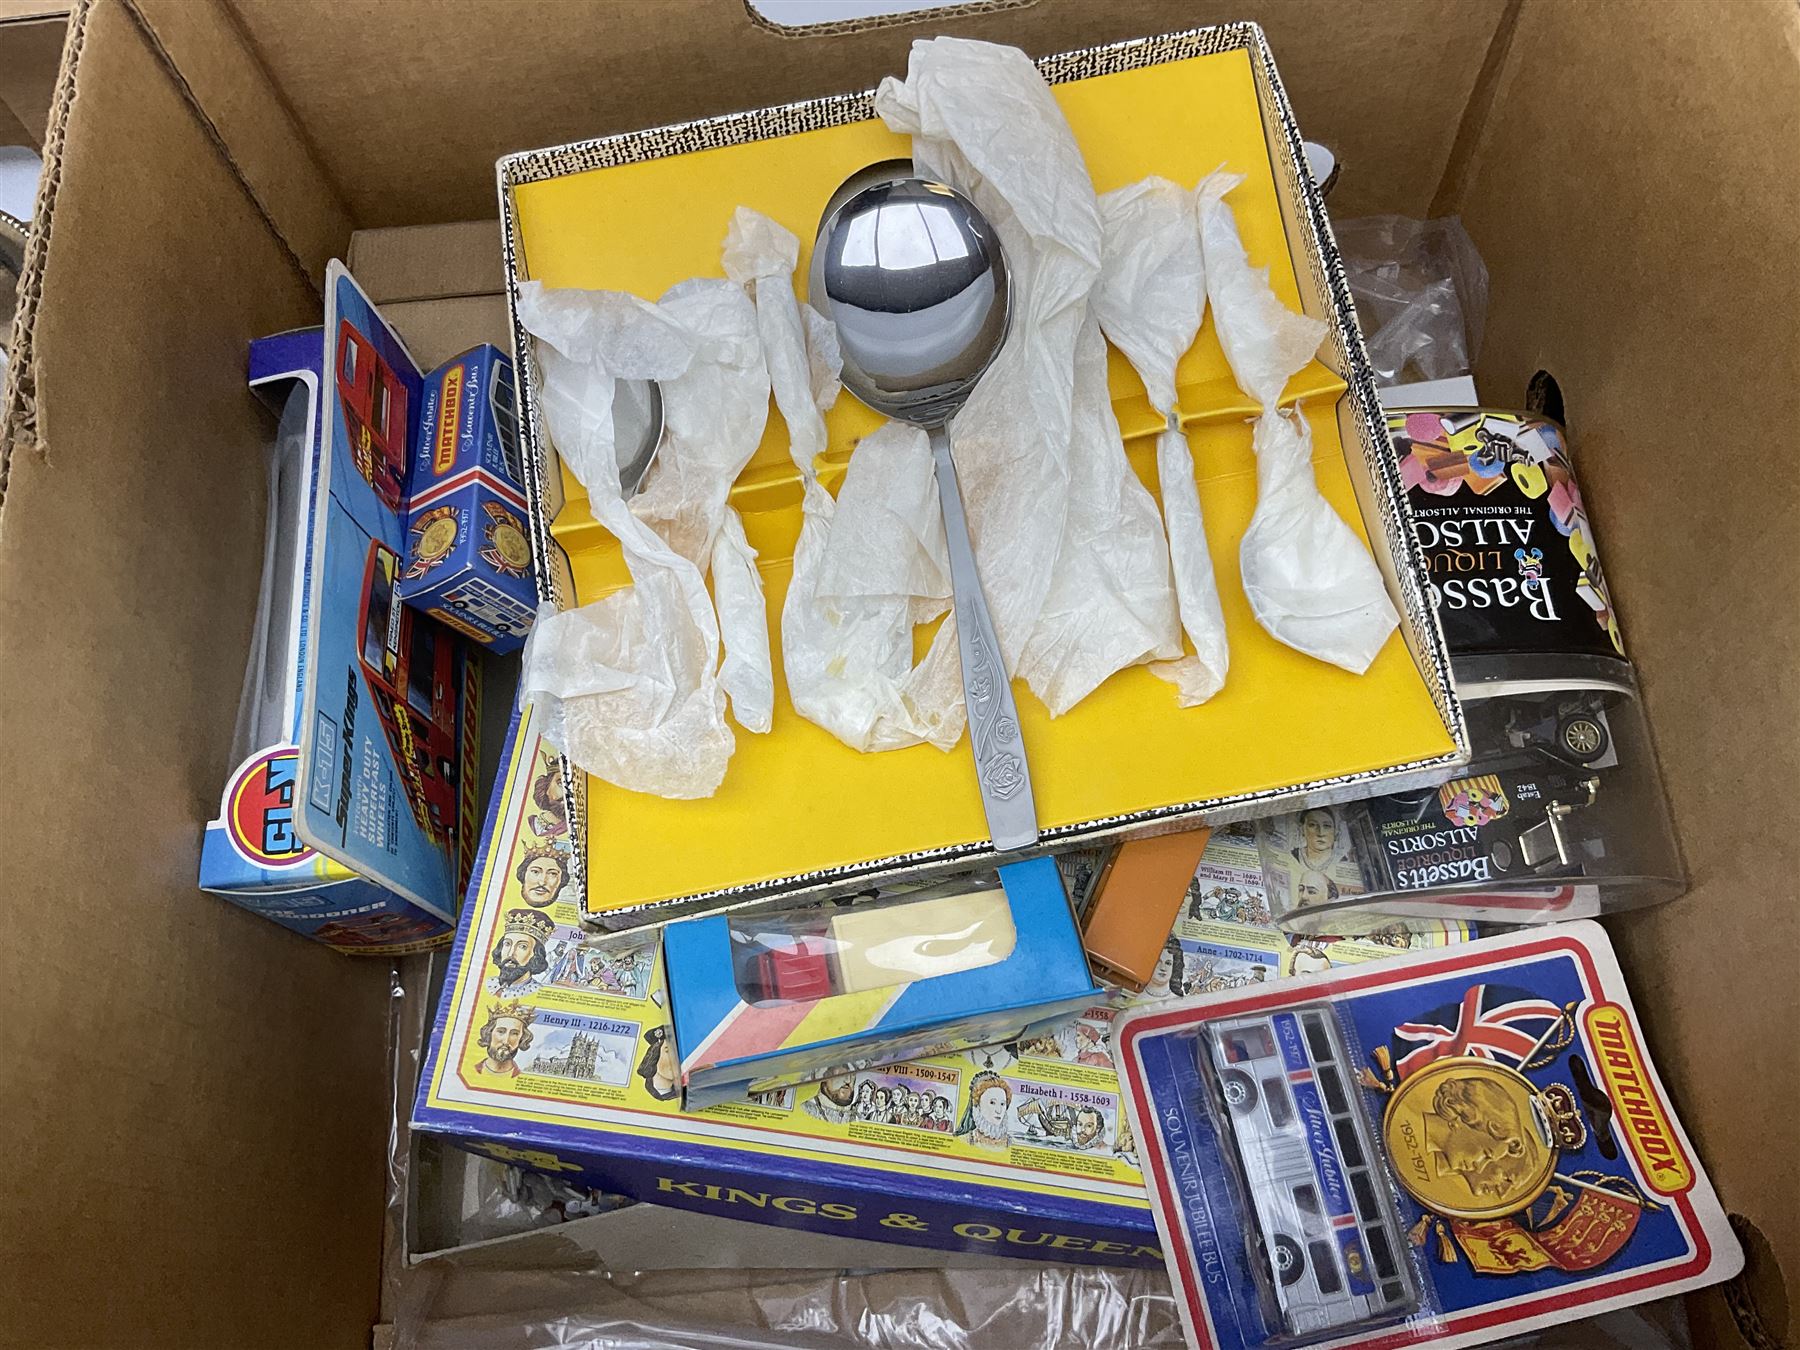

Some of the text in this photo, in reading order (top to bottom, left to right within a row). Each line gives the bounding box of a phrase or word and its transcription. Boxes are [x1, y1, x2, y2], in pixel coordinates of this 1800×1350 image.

[437, 377, 458, 468] MATCHBOX
[461, 365, 478, 452] Souvenir Bus
[1462, 506, 1512, 516] ORIGINAL
[1514, 506, 1533, 515] THE
[296, 665, 305, 693] ENGLAND
[314, 719, 335, 809] K-15
[359, 735, 374, 838] HEAVY DUTY
[367, 748, 381, 844] SUPERFAST
[1517, 783, 1538, 792] 1842
[1517, 791, 1541, 801] Estab
[376, 781, 387, 849] WHEELS
[1381, 818, 1419, 830] ALLSORTS
[1380, 822, 1436, 837] THE ORIGINAL
[1387, 826, 1479, 856] ALLSORTS
[1200, 866, 1224, 876] William
[1396, 846, 1476, 870] LIQUORICE
[1200, 872, 1211, 880] and
[1212, 873, 1228, 883] Mary
[1197, 945, 1217, 955] Anne
[1224, 949, 1263, 963] 1702-1714
[543, 1014, 570, 1029] Henry
[571, 1018, 581, 1027] III
[588, 1020, 632, 1035] 1216-1272
[1280, 1018, 1303, 1066] 1952-1977
[893, 1065, 908, 1075] VIII
[915, 1068, 956, 1082] 1509-1547
[1020, 1084, 1057, 1098] Elizabeth
[1059, 1090, 1063, 1099] I
[1070, 1092, 1111, 1106] 1558-1603
[1595, 1016, 1683, 1179] MATCHBOX
[1301, 1090, 1341, 1207] Silver Jubilee
[1399, 1119, 1431, 1183] 1952-1977
[656, 1177, 858, 1220] KINGS
[879, 1213, 931, 1231] &
[1163, 1107, 1224, 1285] SOUVENIR JUBILEE BUS
